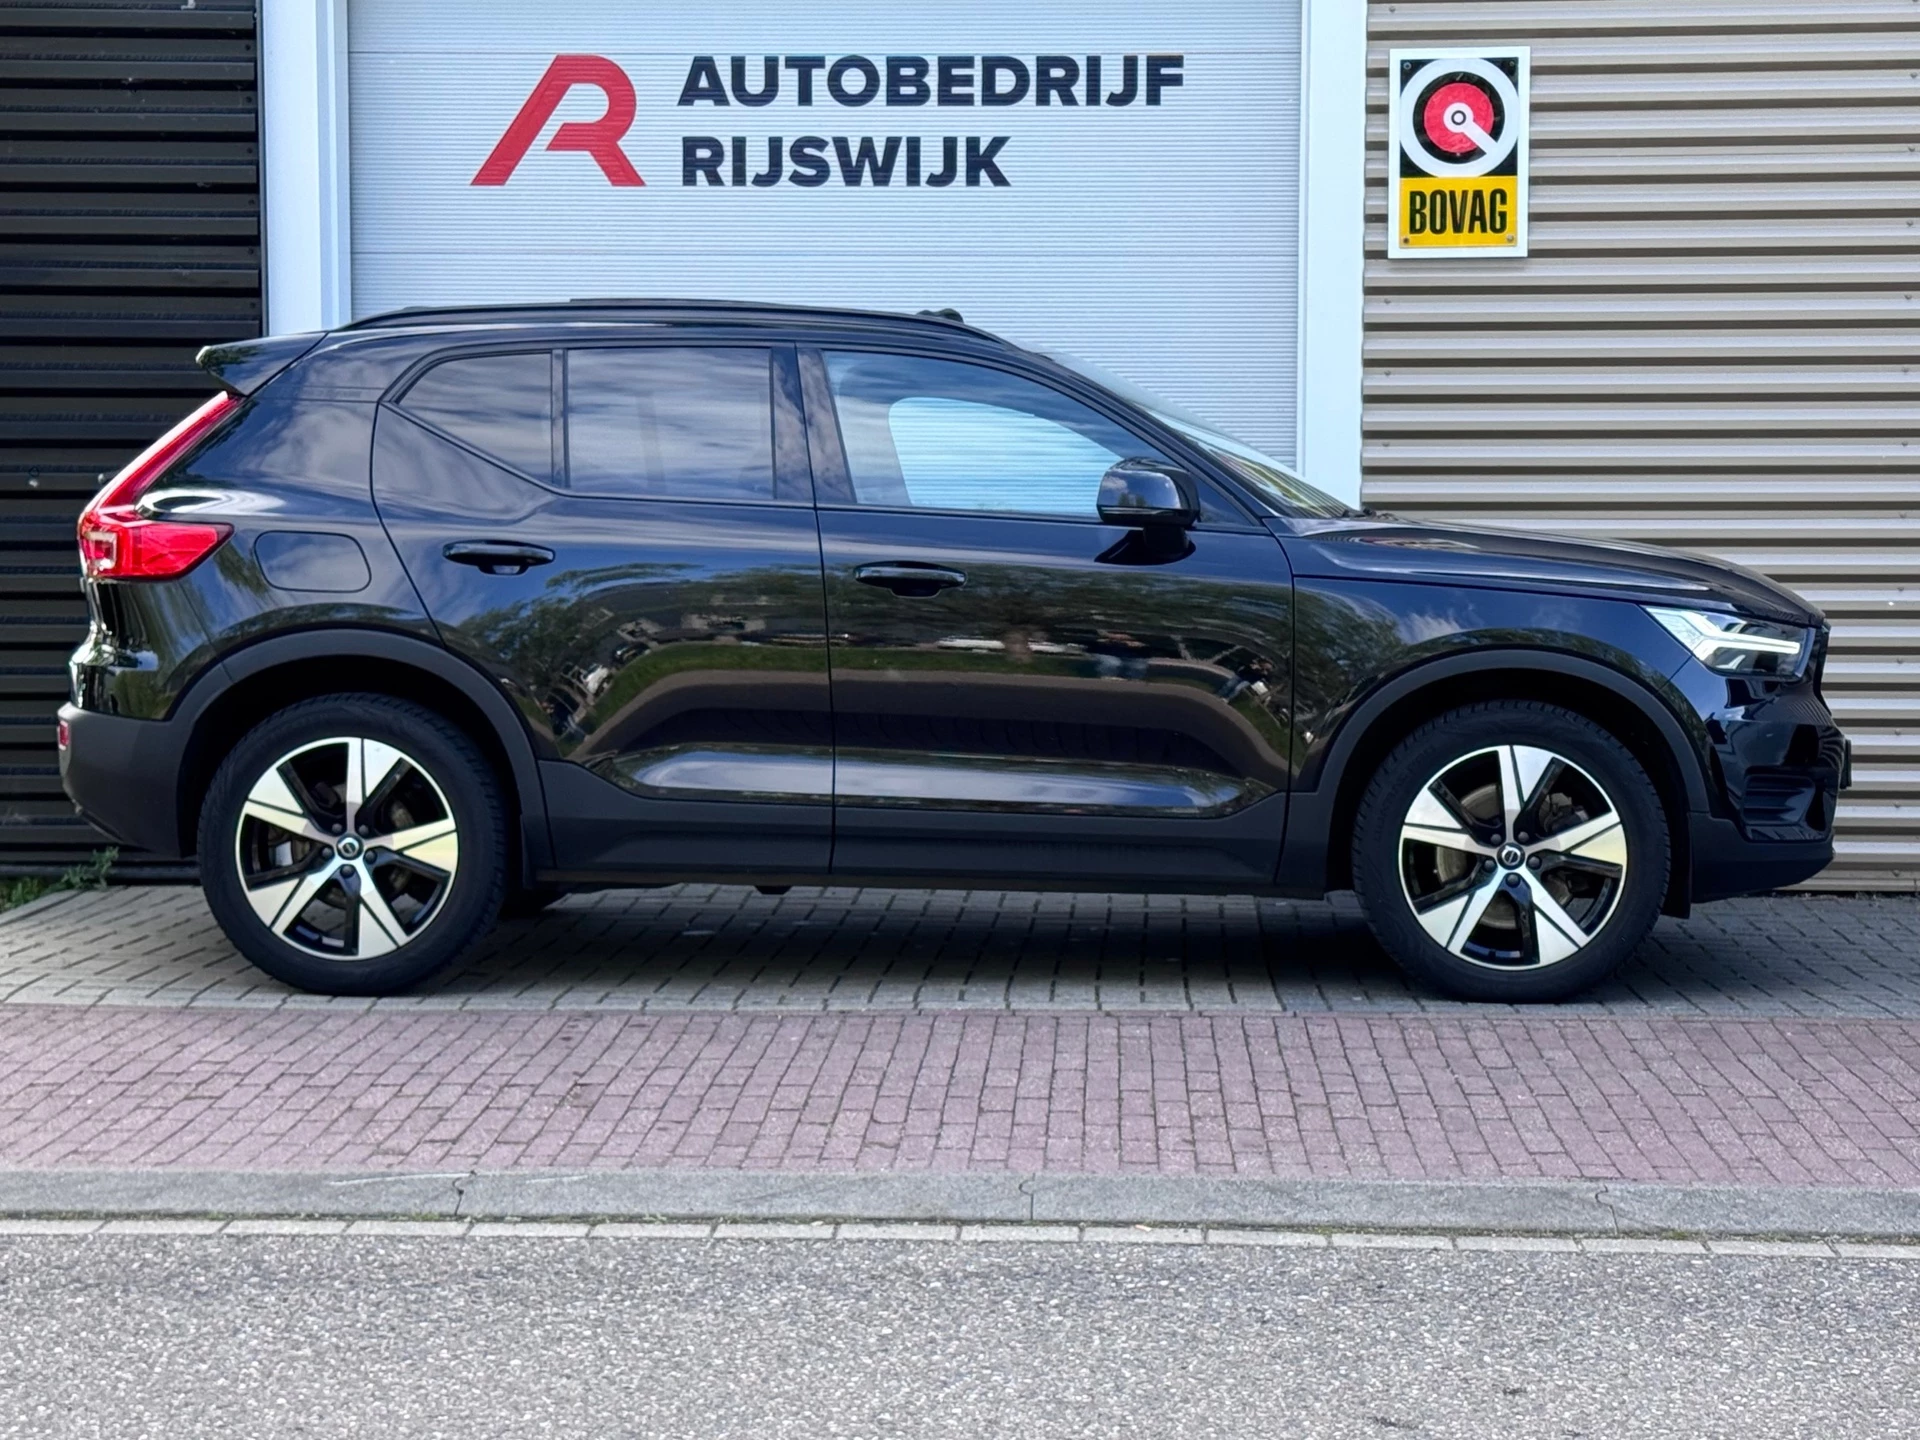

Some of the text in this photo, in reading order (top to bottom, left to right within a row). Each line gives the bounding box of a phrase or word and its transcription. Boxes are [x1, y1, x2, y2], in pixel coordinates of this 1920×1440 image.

[678, 55, 1184, 106] AUTOBEDRIJF
[682, 136, 1012, 187] RIJSWIJK
[1409, 188, 1508, 235] BOVAG
